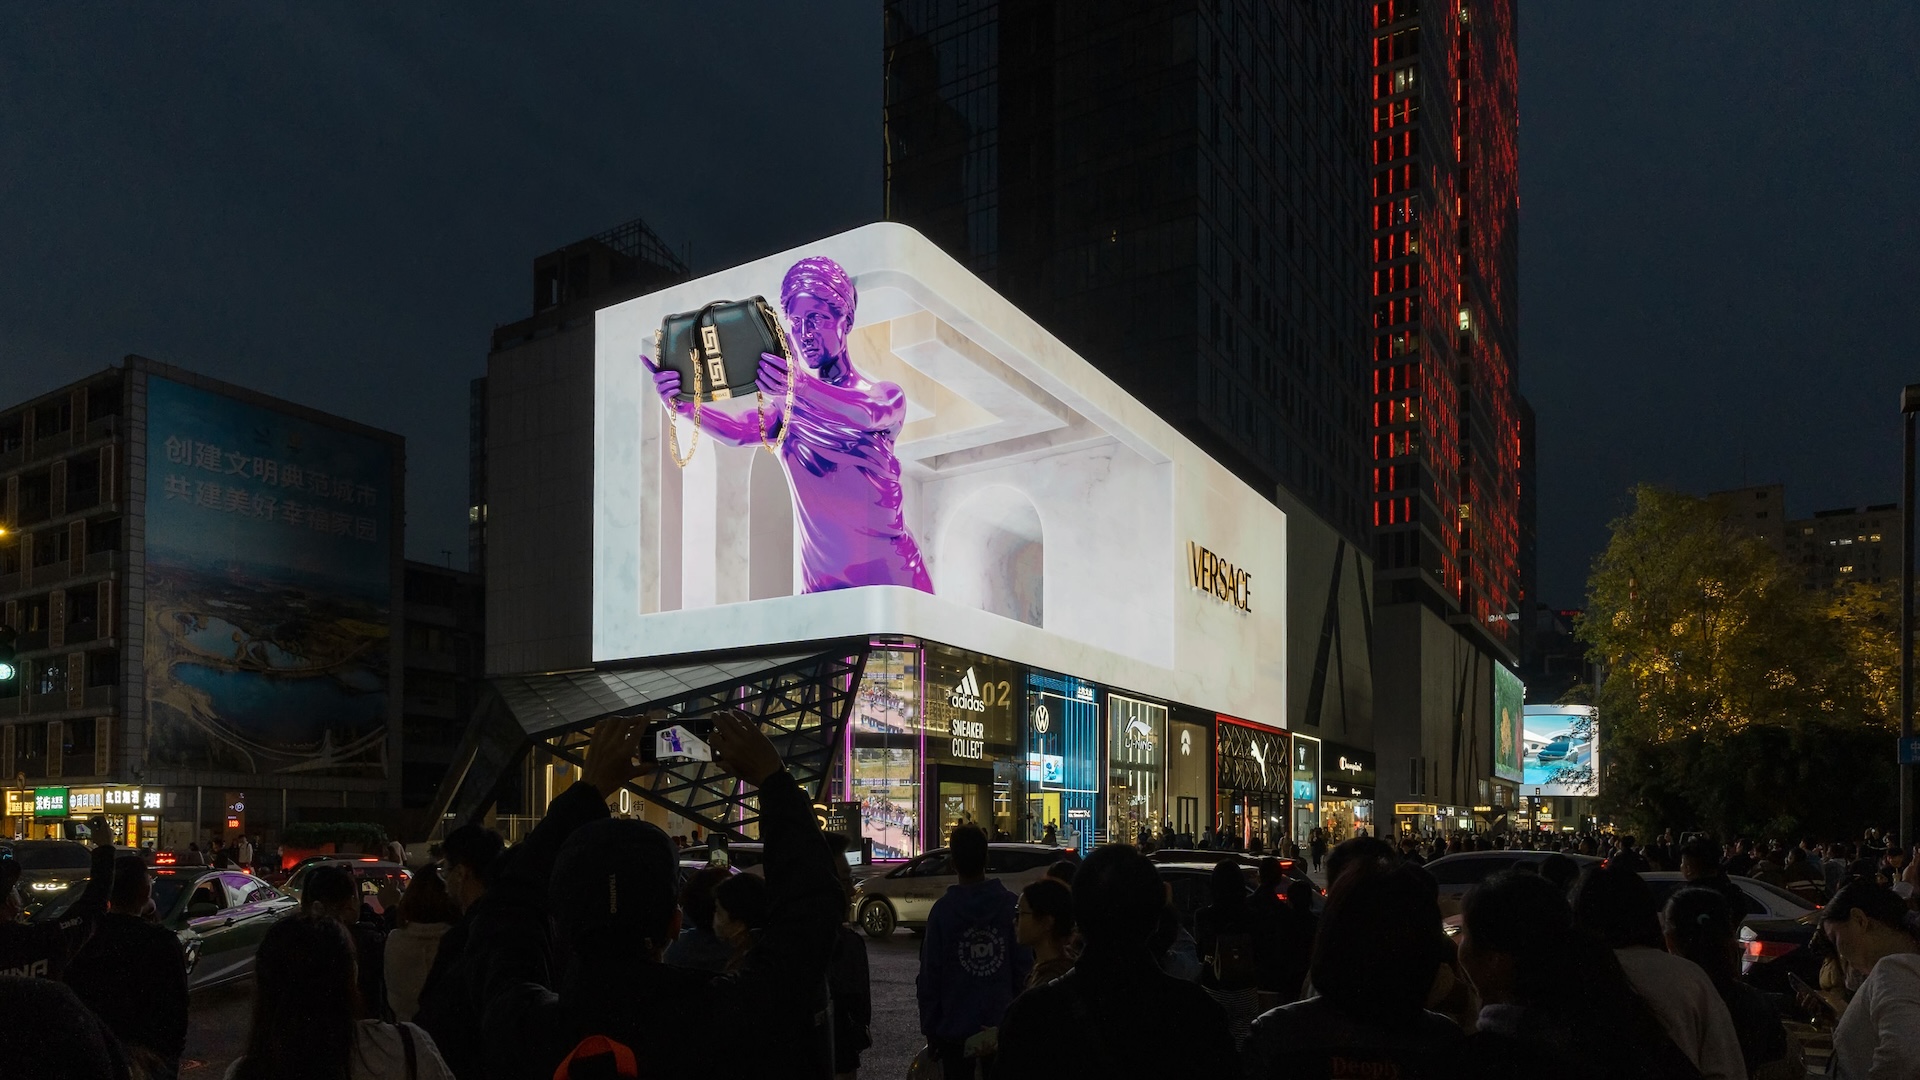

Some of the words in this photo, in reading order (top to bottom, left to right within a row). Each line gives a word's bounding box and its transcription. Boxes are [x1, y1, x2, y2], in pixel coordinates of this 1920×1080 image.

[165, 435, 378, 507] 创建文明典范城市
[164, 474, 378, 543] 共建美好幸福家园
[1188, 540, 1252, 613] VERSACE
[952, 695, 985, 712] adidas
[952, 719, 984, 739] SNEAKER
[952, 738, 984, 759] COLLECT
